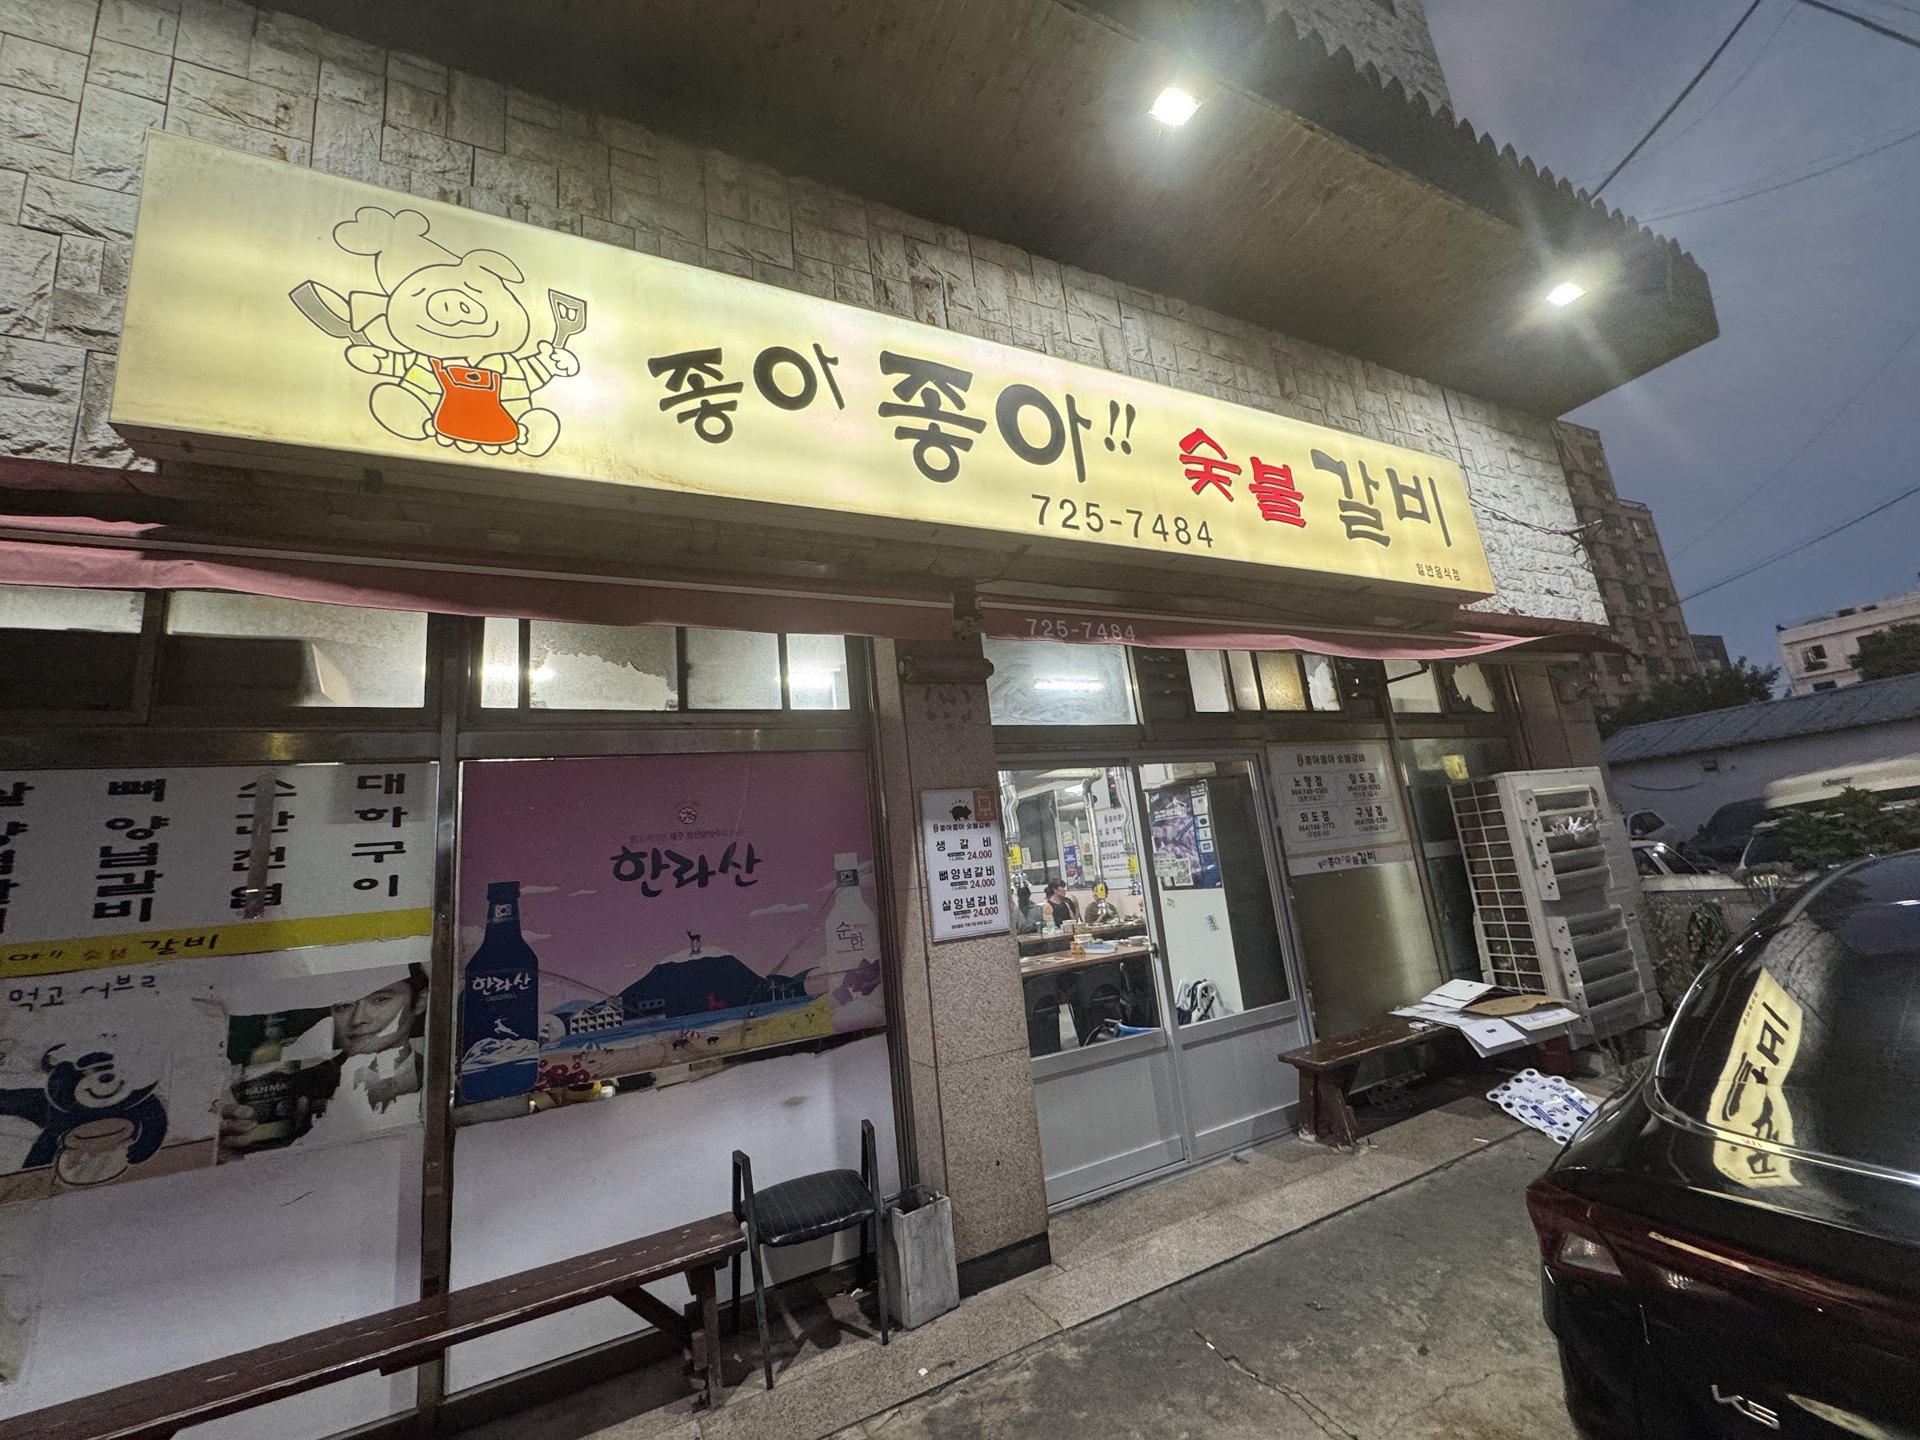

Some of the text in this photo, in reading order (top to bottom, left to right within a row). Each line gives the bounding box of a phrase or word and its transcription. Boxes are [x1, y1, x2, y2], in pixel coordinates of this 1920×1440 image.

[647, 342, 845, 444] 좋아
[1179, 428, 1307, 528] 숯불
[1310, 448, 1452, 548] 갈비
[1031, 493, 1214, 548] 725-7484
[1415, 562, 1461, 582] 일반음식점
[1025, 618, 1136, 641] 725-7484
[350, 772, 409, 898] 대하구이
[967, 850, 993, 861] 24,000
[610, 842, 762, 898] 한라산
[970, 878, 996, 889] 24,000
[942, 893, 999, 912] 살양념갈비
[973, 906, 999, 918] 24,000
[140, 933, 219, 956] 갈비
[472, 973, 532, 996] 한라산
